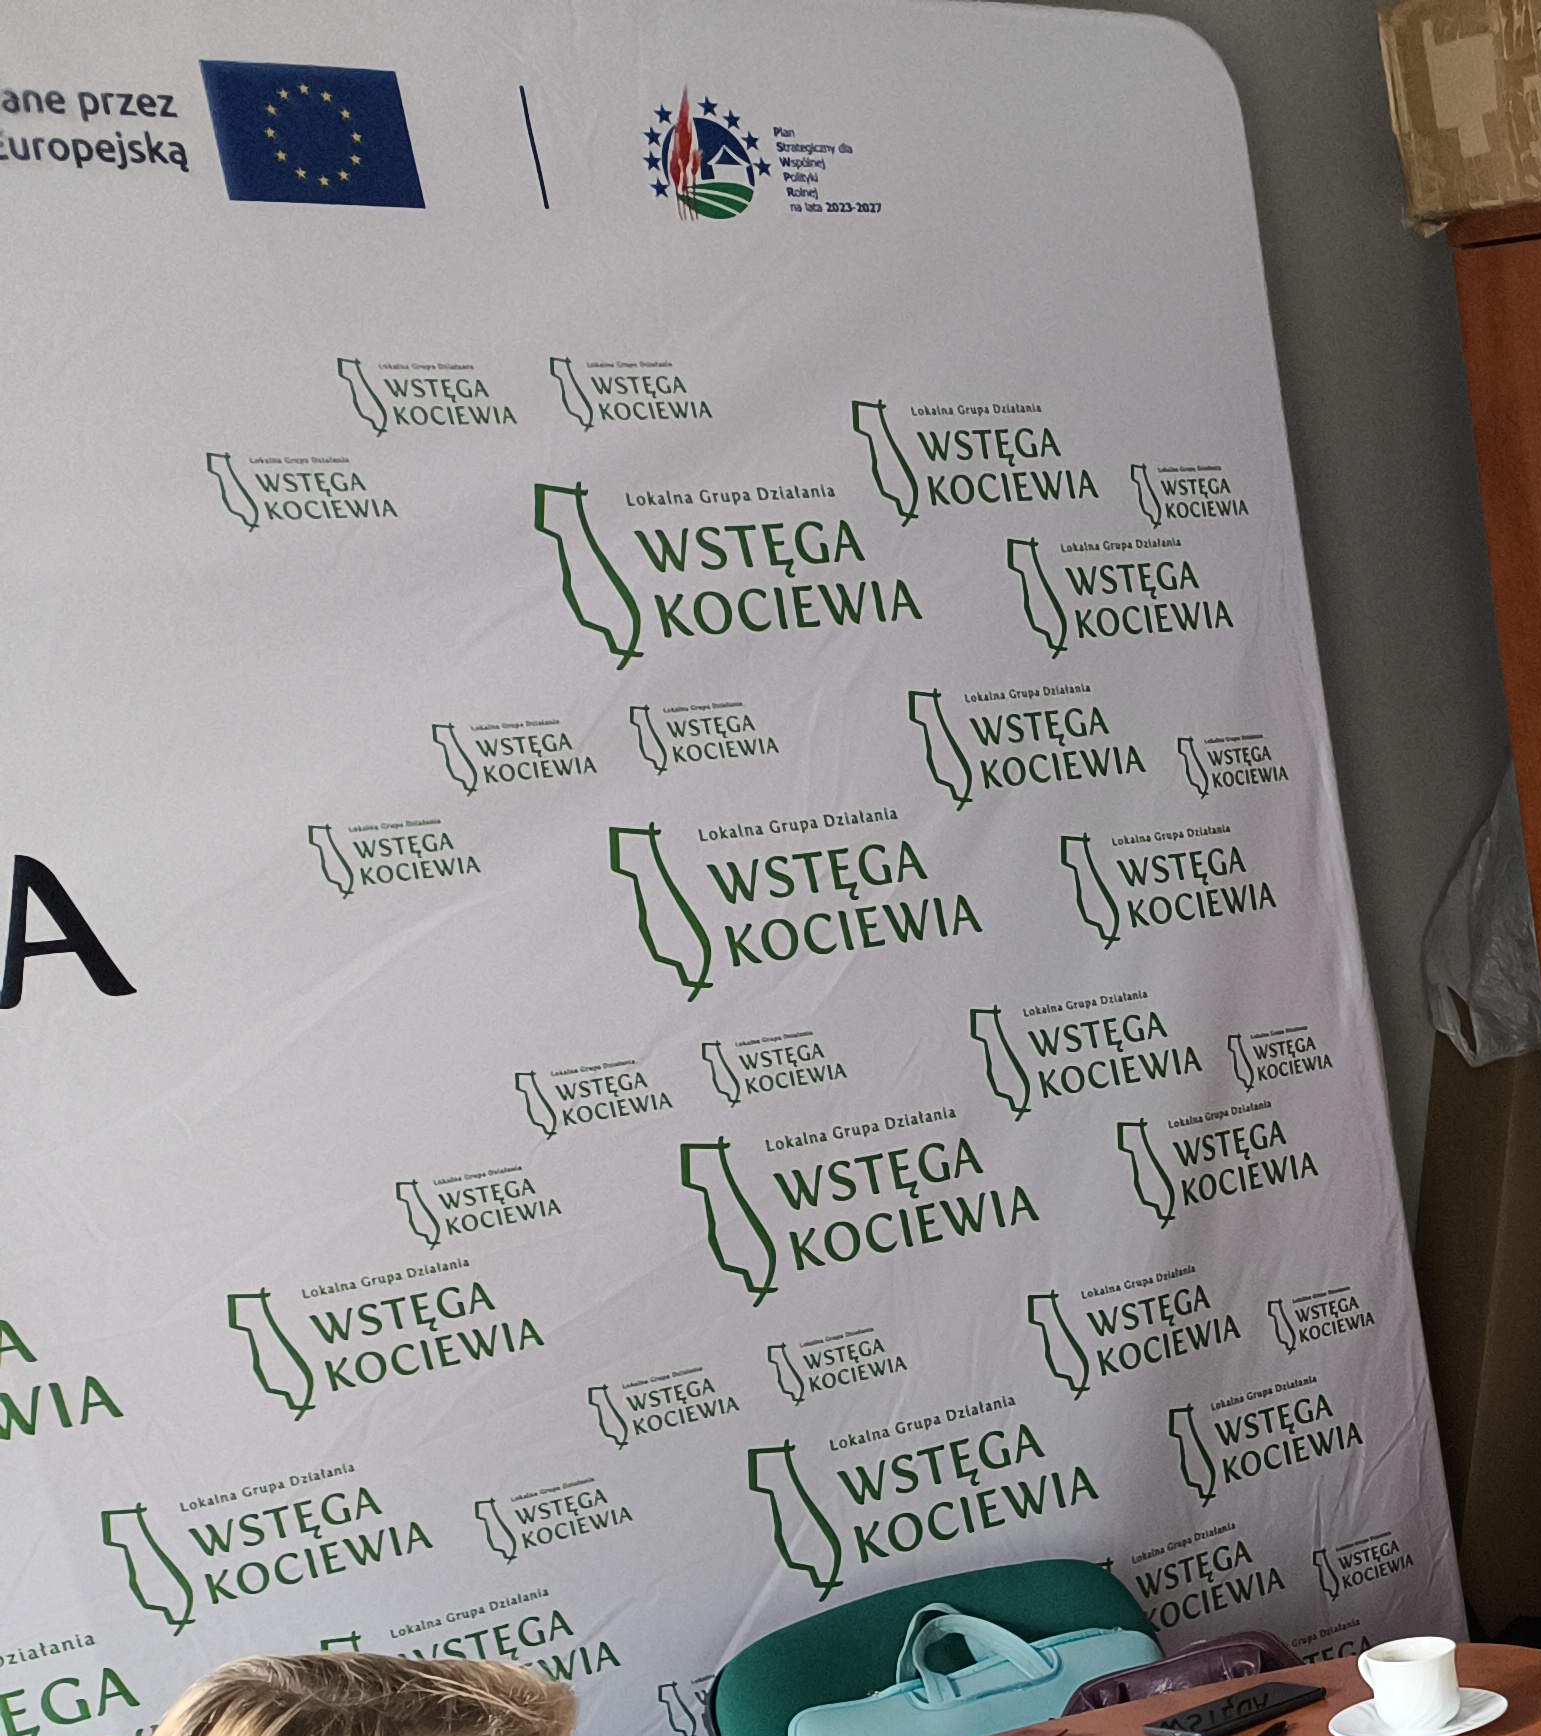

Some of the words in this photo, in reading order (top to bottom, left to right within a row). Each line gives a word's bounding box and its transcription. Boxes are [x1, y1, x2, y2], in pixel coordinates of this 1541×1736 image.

[77, 91, 178, 122] przez
[825, 202, 882, 213] 2023-2027
[383, 378, 490, 404] WSTĘGA
[590, 375, 688, 400] WSTĘGA
[598, 400, 713, 421] KOCIEWIA
[392, 405, 518, 426] KOCIEWIA
[916, 427, 1062, 468] WSTĘGA
[626, 490, 693, 506] Lokalna
[700, 489, 751, 505] Grupa
[757, 484, 836, 500] Działania
[926, 468, 1100, 507] KOCIEWIA
[633, 519, 866, 579] WSTĘGA
[1064, 560, 1200, 601] WSTĘGA
[653, 578, 923, 639] KOCIEWIA
[1074, 599, 1235, 639] KOCIEWIA
[474, 732, 573, 758] WSTĘGA
[968, 706, 1110, 748] WSTĘGA
[482, 756, 598, 784] KOCIEWIA
[979, 744, 1147, 790] KOCIEWIA
[352, 832, 455, 859] WSTĘGA
[698, 824, 764, 841] Lokalna
[769, 819, 818, 833] Grupa
[823, 807, 898, 827] Działania
[359, 855, 482, 886] KOCIEWIA
[706, 840, 929, 905] WSTĘGA
[1116, 846, 1247, 888] WSTĘGA
[1126, 881, 1277, 929] KOCIEWIA
[724, 893, 983, 968] KOCIEWIA
[1027, 1011, 1168, 1058] WSTĘGA
[1037, 1045, 1203, 1099] KOCIEWIA
[765, 1132, 827, 1152] Lokalna
[833, 1123, 880, 1139] Grupa
[885, 1107, 956, 1130] Działania
[1172, 1120, 1287, 1167] WSTĘGA
[437, 1178, 537, 1211] WSTĘGA
[772, 1137, 985, 1211] WSTĘGA
[1180, 1151, 1319, 1207] KOCIEWIA
[445, 1198, 563, 1236] KOCIEWIA
[788, 1185, 1040, 1271] KOCIEWIA
[308, 1281, 496, 1345] WSTĘGA
[1086, 1284, 1211, 1337] WSTĘGA
[324, 1317, 545, 1392] KOCIEWIA
[802, 1338, 886, 1370] WSTĘGA
[1096, 1314, 1242, 1377] KOCIEWIA
[808, 1355, 908, 1393] KOCIEWIA
[830, 1429, 890, 1451] Lokalna
[895, 1416, 941, 1434] Grupa
[946, 1396, 1016, 1422] Działania
[1213, 1393, 1334, 1447] WSTĘGA
[836, 1423, 1046, 1506] WSTĘGA
[1222, 1421, 1364, 1484] KOCIEWIA
[187, 1486, 383, 1557] WSTĘGA
[853, 1466, 1100, 1564] KOCIEWIA
[203, 1521, 434, 1605] KOCIEWIA
[1135, 1540, 1253, 1599] WSTĘGA
[390, 1619, 442, 1638] Lokalna
[446, 1607, 485, 1622] Grupa
[489, 1588, 549, 1611] Działania
